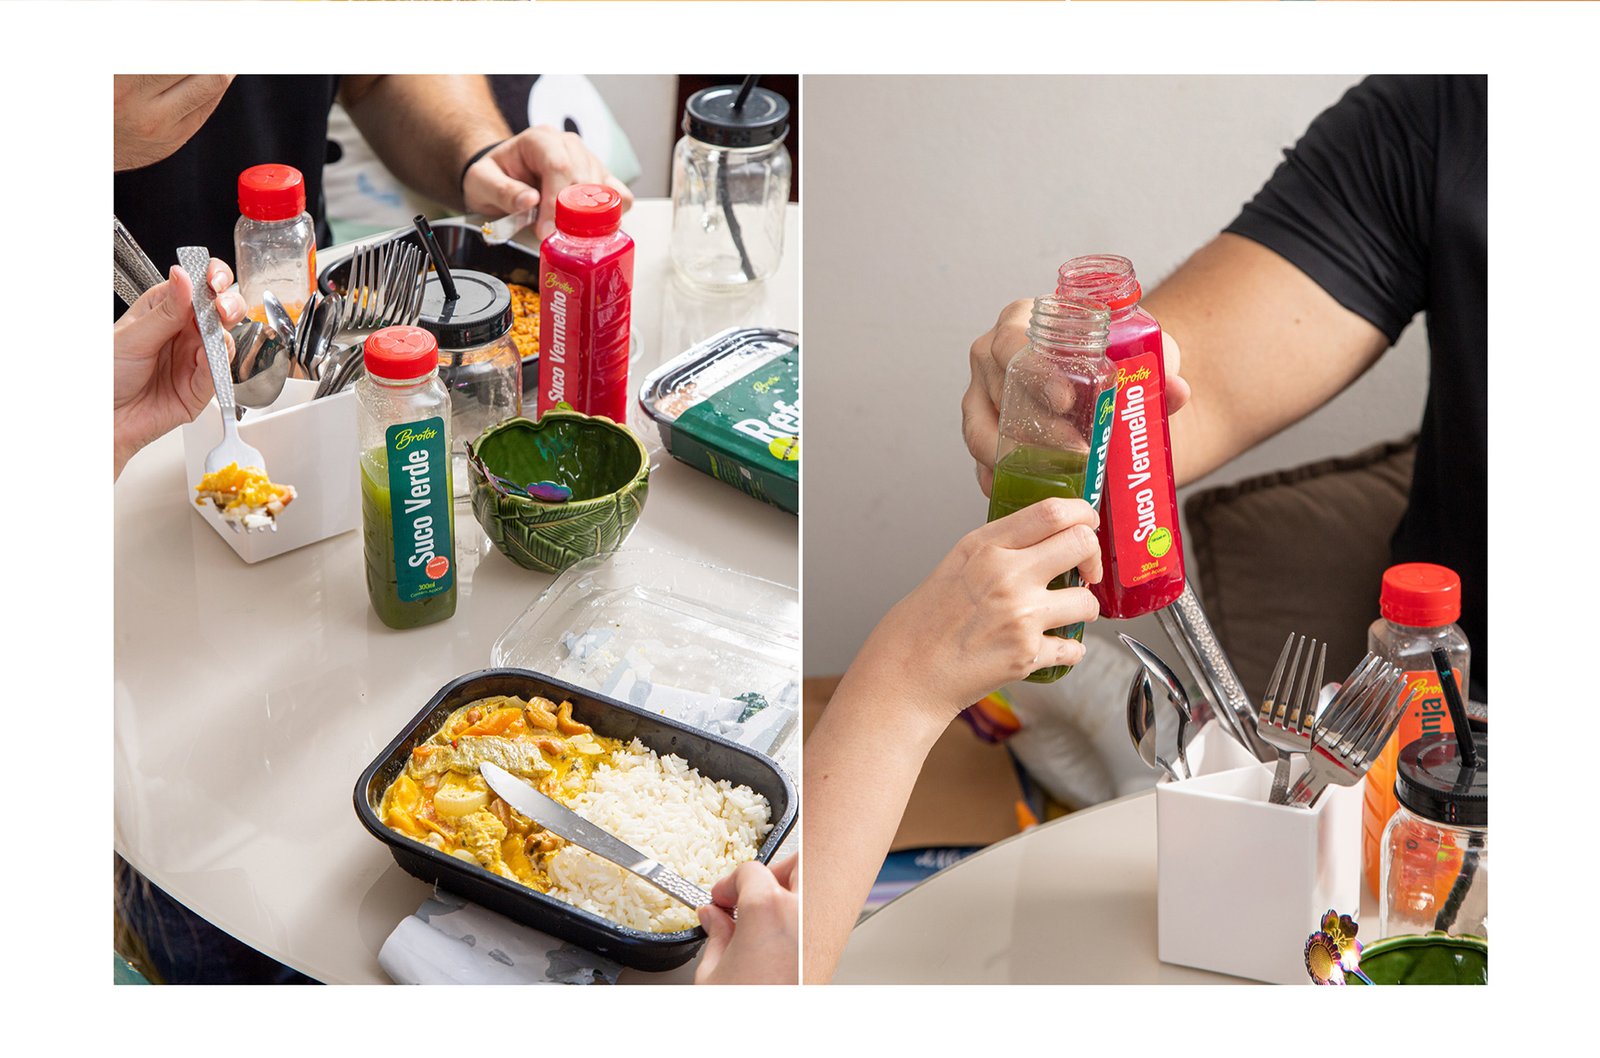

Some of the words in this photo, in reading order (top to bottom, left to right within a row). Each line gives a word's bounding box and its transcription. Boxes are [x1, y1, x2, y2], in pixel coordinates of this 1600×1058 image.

[545, 271, 575, 295] Brotos
[549, 290, 567, 363] Vermelho
[548, 366, 565, 403] Suco
[1117, 366, 1152, 393] Brotos
[394, 427, 438, 451] Brotos
[732, 399, 799, 444] Ref
[1120, 384, 1152, 490] Vermelho
[401, 449, 432, 514] Verde
[1090, 425, 1111, 508] Verde
[1133, 487, 1157, 543] Suco
[408, 515, 435, 568] Suco
[1414, 697, 1446, 739] nja
